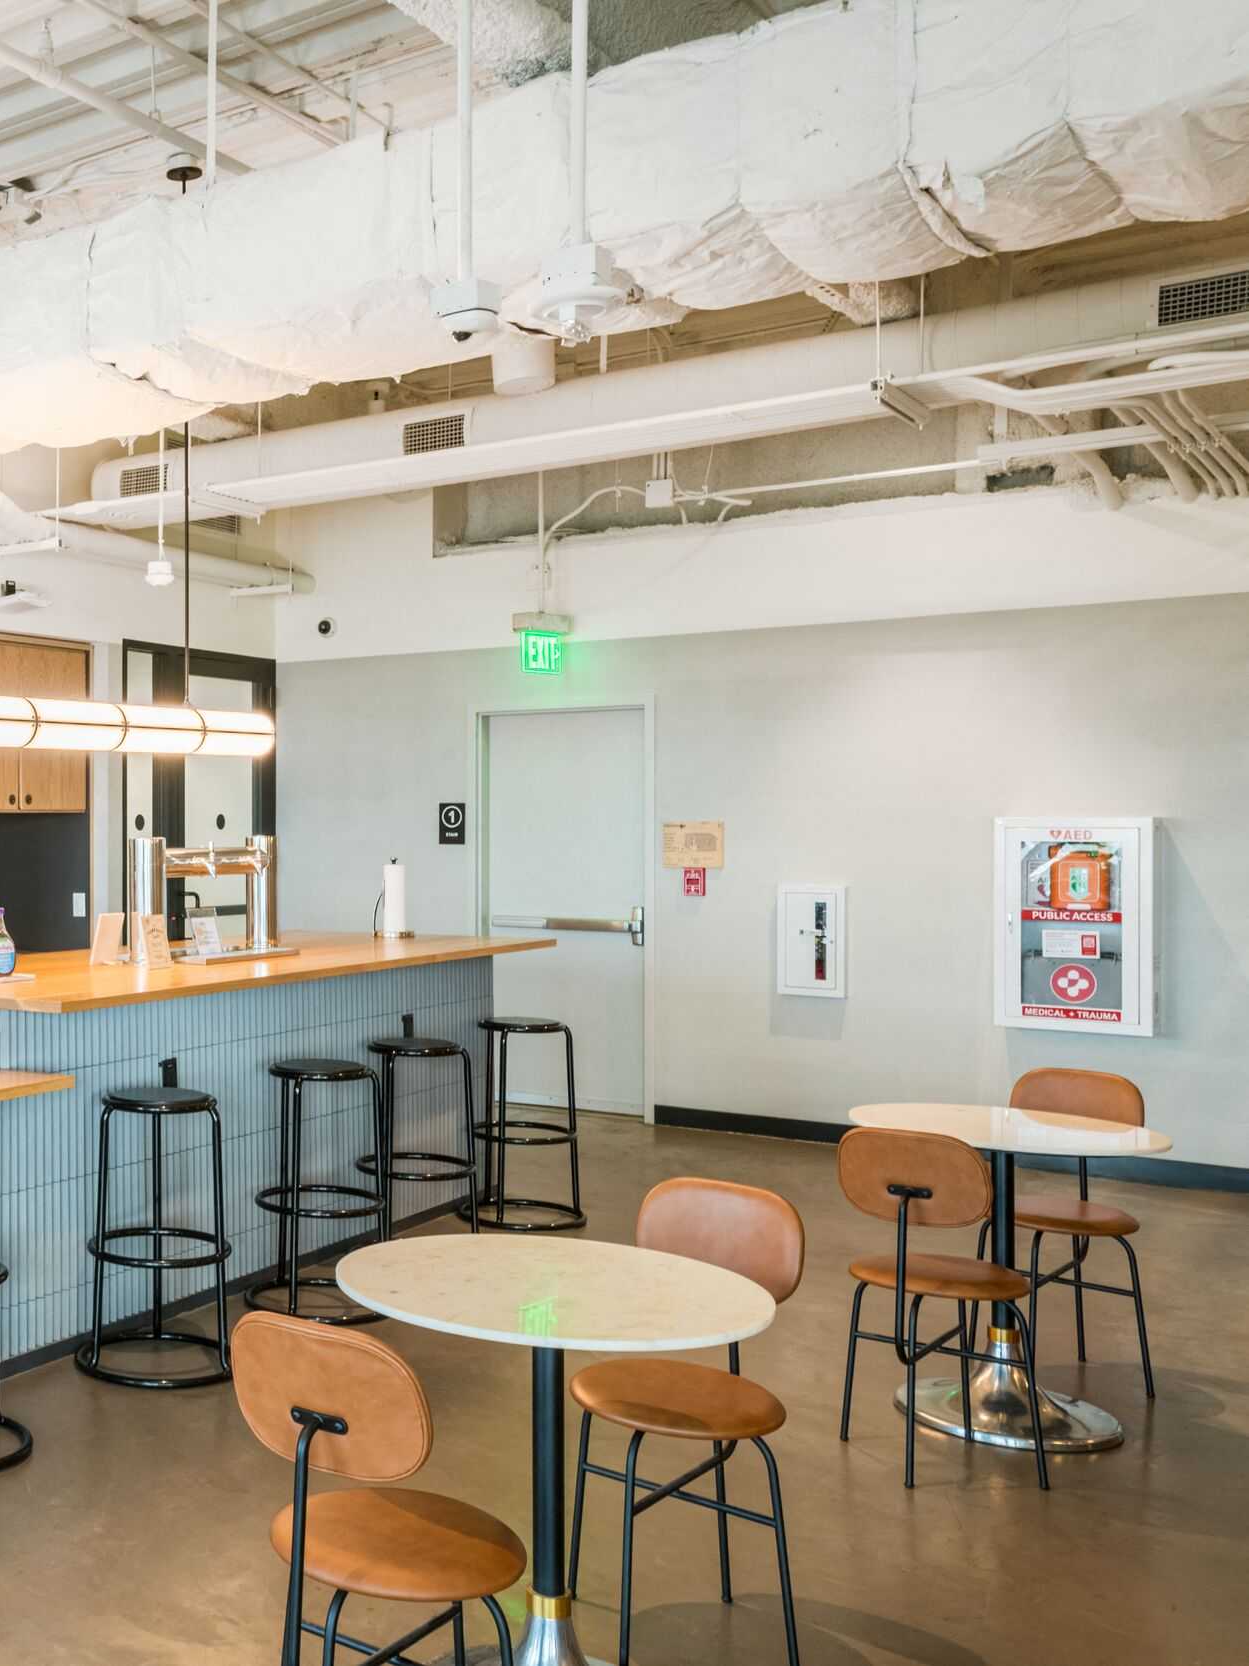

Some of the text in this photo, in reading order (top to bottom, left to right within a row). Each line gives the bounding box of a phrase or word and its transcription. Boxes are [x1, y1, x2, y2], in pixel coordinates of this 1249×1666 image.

[528, 636, 558, 669] EXIT
[448, 810, 455, 824] 1
[1063, 829, 1093, 840] AED
[1032, 910, 1114, 922] PUBLIC ACCESS
[1024, 1007, 1067, 1018] MEDICAL
[1077, 1010, 1119, 1021] TRAUMA
